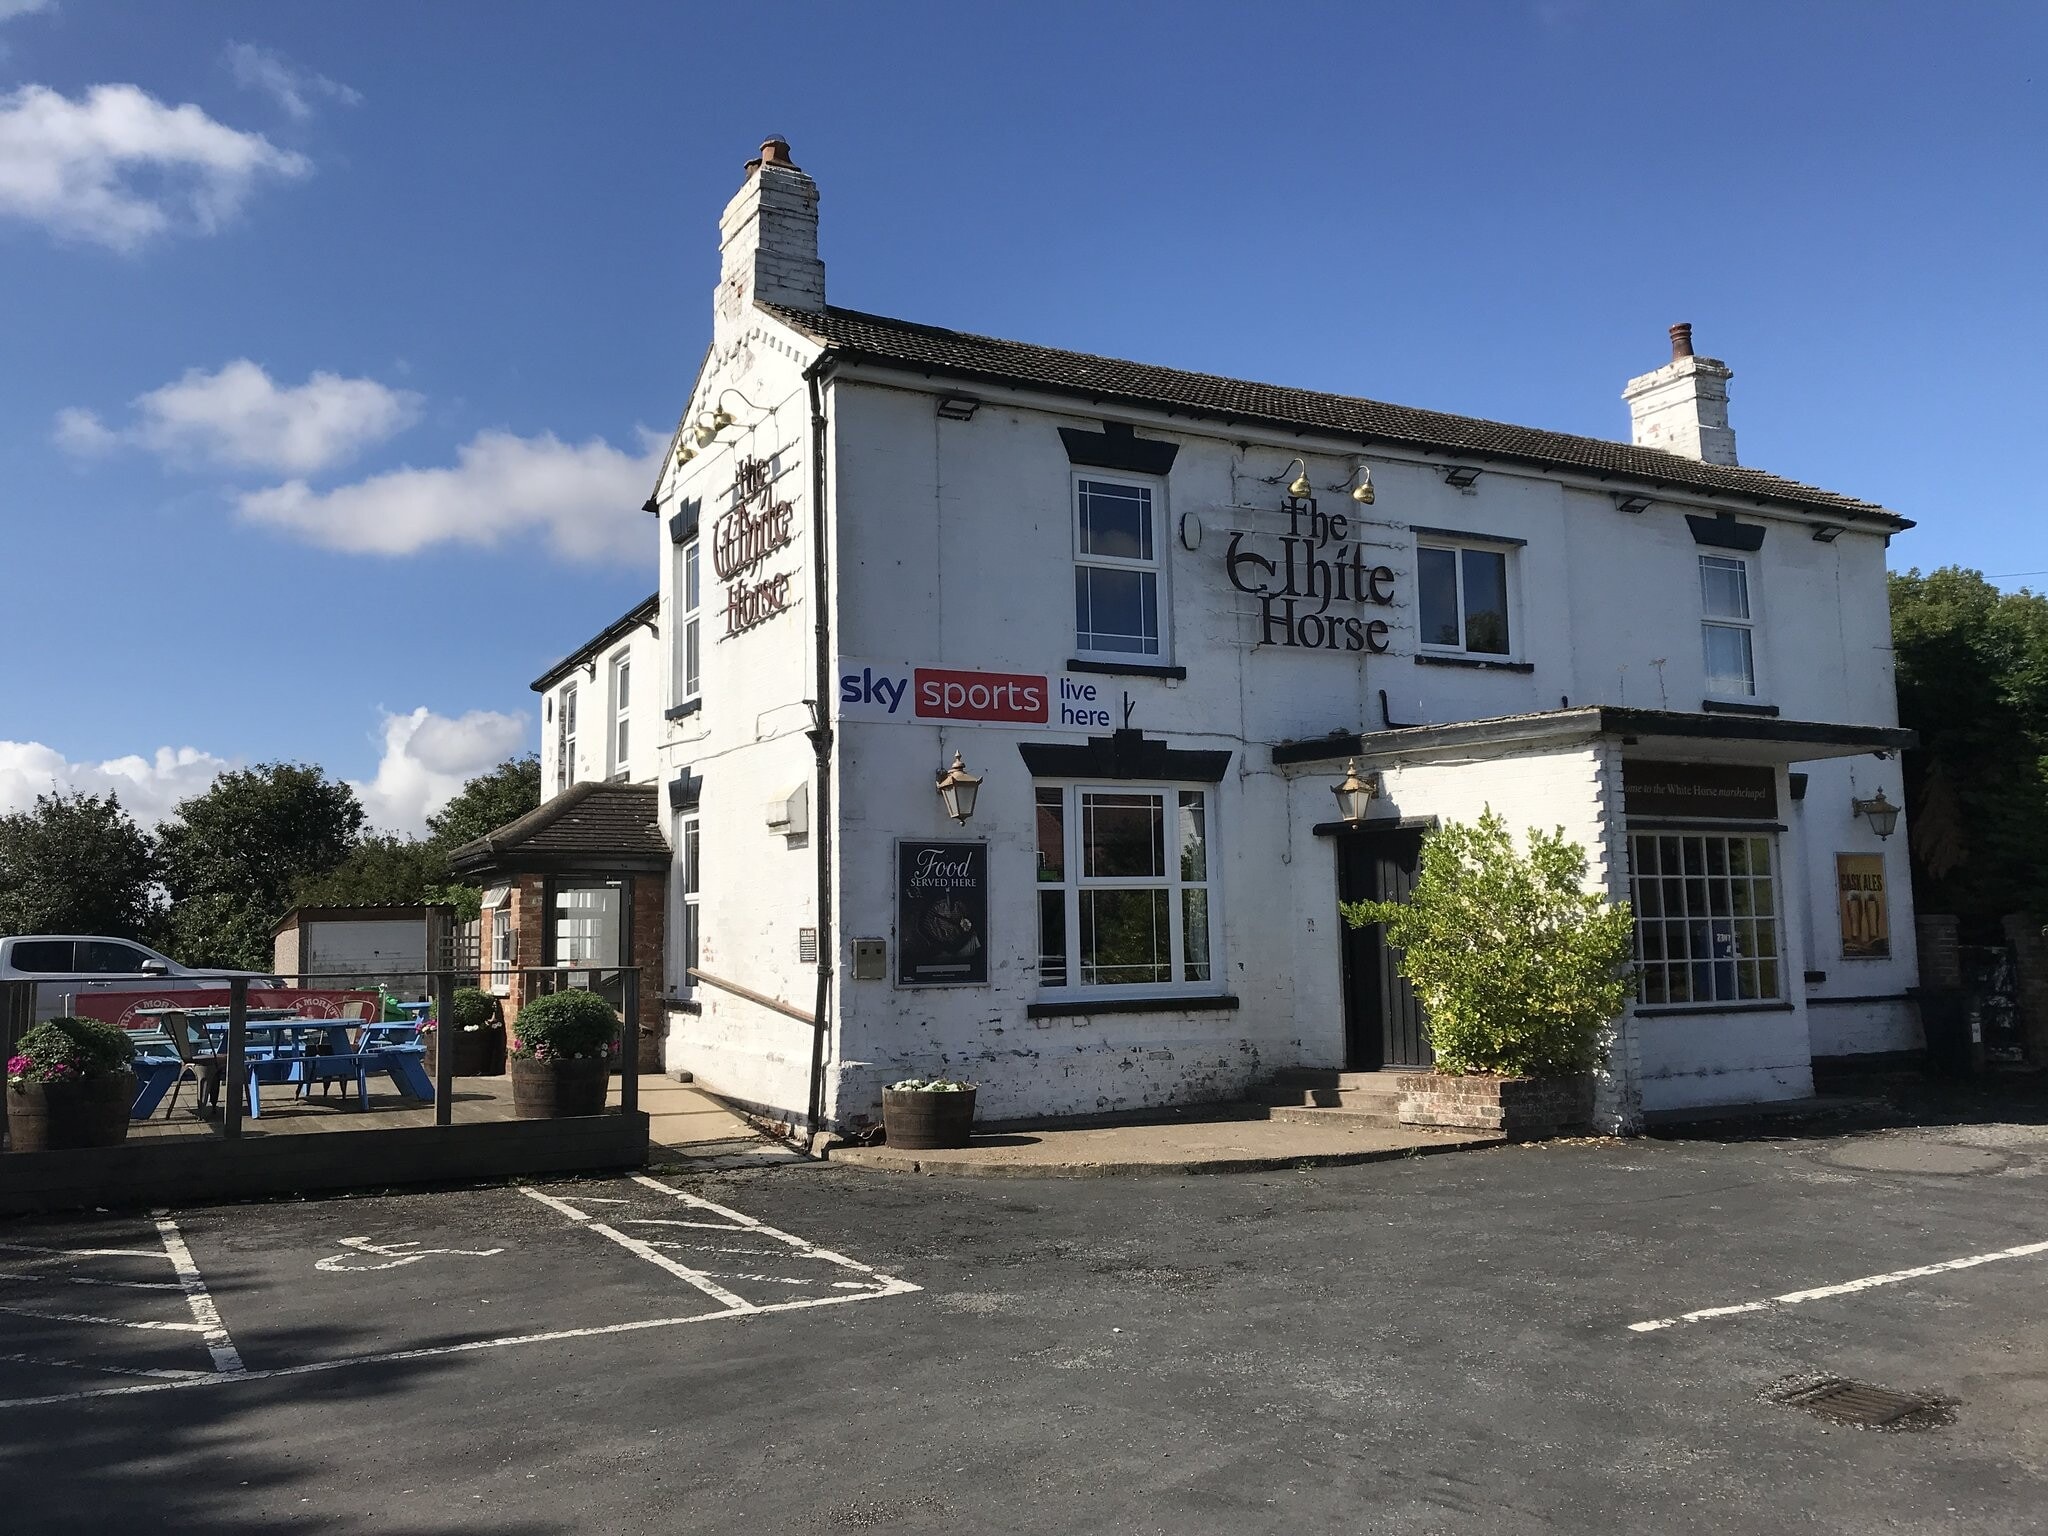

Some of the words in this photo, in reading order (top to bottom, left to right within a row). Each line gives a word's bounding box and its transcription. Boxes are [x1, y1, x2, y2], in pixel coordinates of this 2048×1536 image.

[712, 487, 793, 579] White
[1281, 495, 1348, 549] The
[1226, 532, 1395, 614] White
[726, 572, 788, 634] Horse
[1257, 597, 1390, 654] Horse
[840, 667, 908, 714] sky
[922, 680, 1041, 714] sports
[1060, 677, 1097, 701] live
[1061, 702, 1110, 727] here
[1644, 784, 1652, 793] to
[1654, 783, 1666, 794] the
[1667, 783, 1692, 796] White
[1694, 784, 1717, 797] Horse
[911, 877, 949, 887] SERVED
[951, 877, 977, 887] HERE
[914, 848, 973, 879] Food
[1841, 873, 1861, 891] CASK
[1863, 873, 1882, 891] ALES
